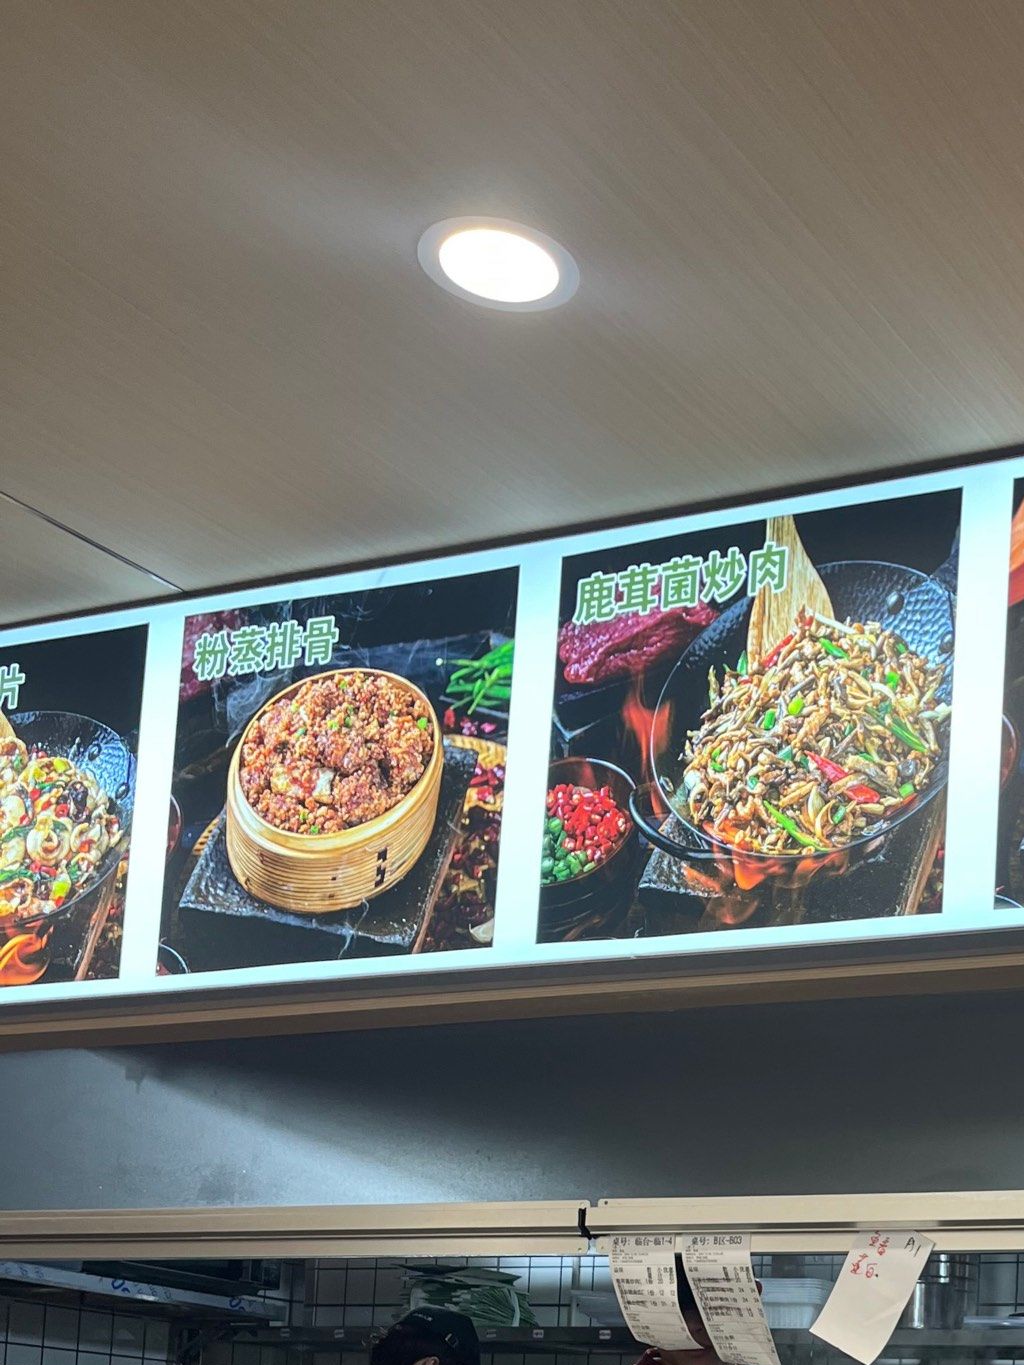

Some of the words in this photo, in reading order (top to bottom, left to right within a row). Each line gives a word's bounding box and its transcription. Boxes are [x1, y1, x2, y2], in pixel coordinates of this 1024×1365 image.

[572, 542, 788, 626] 鹿茸菌炒肉
[192, 615, 339, 681] 粉蒸排骨
